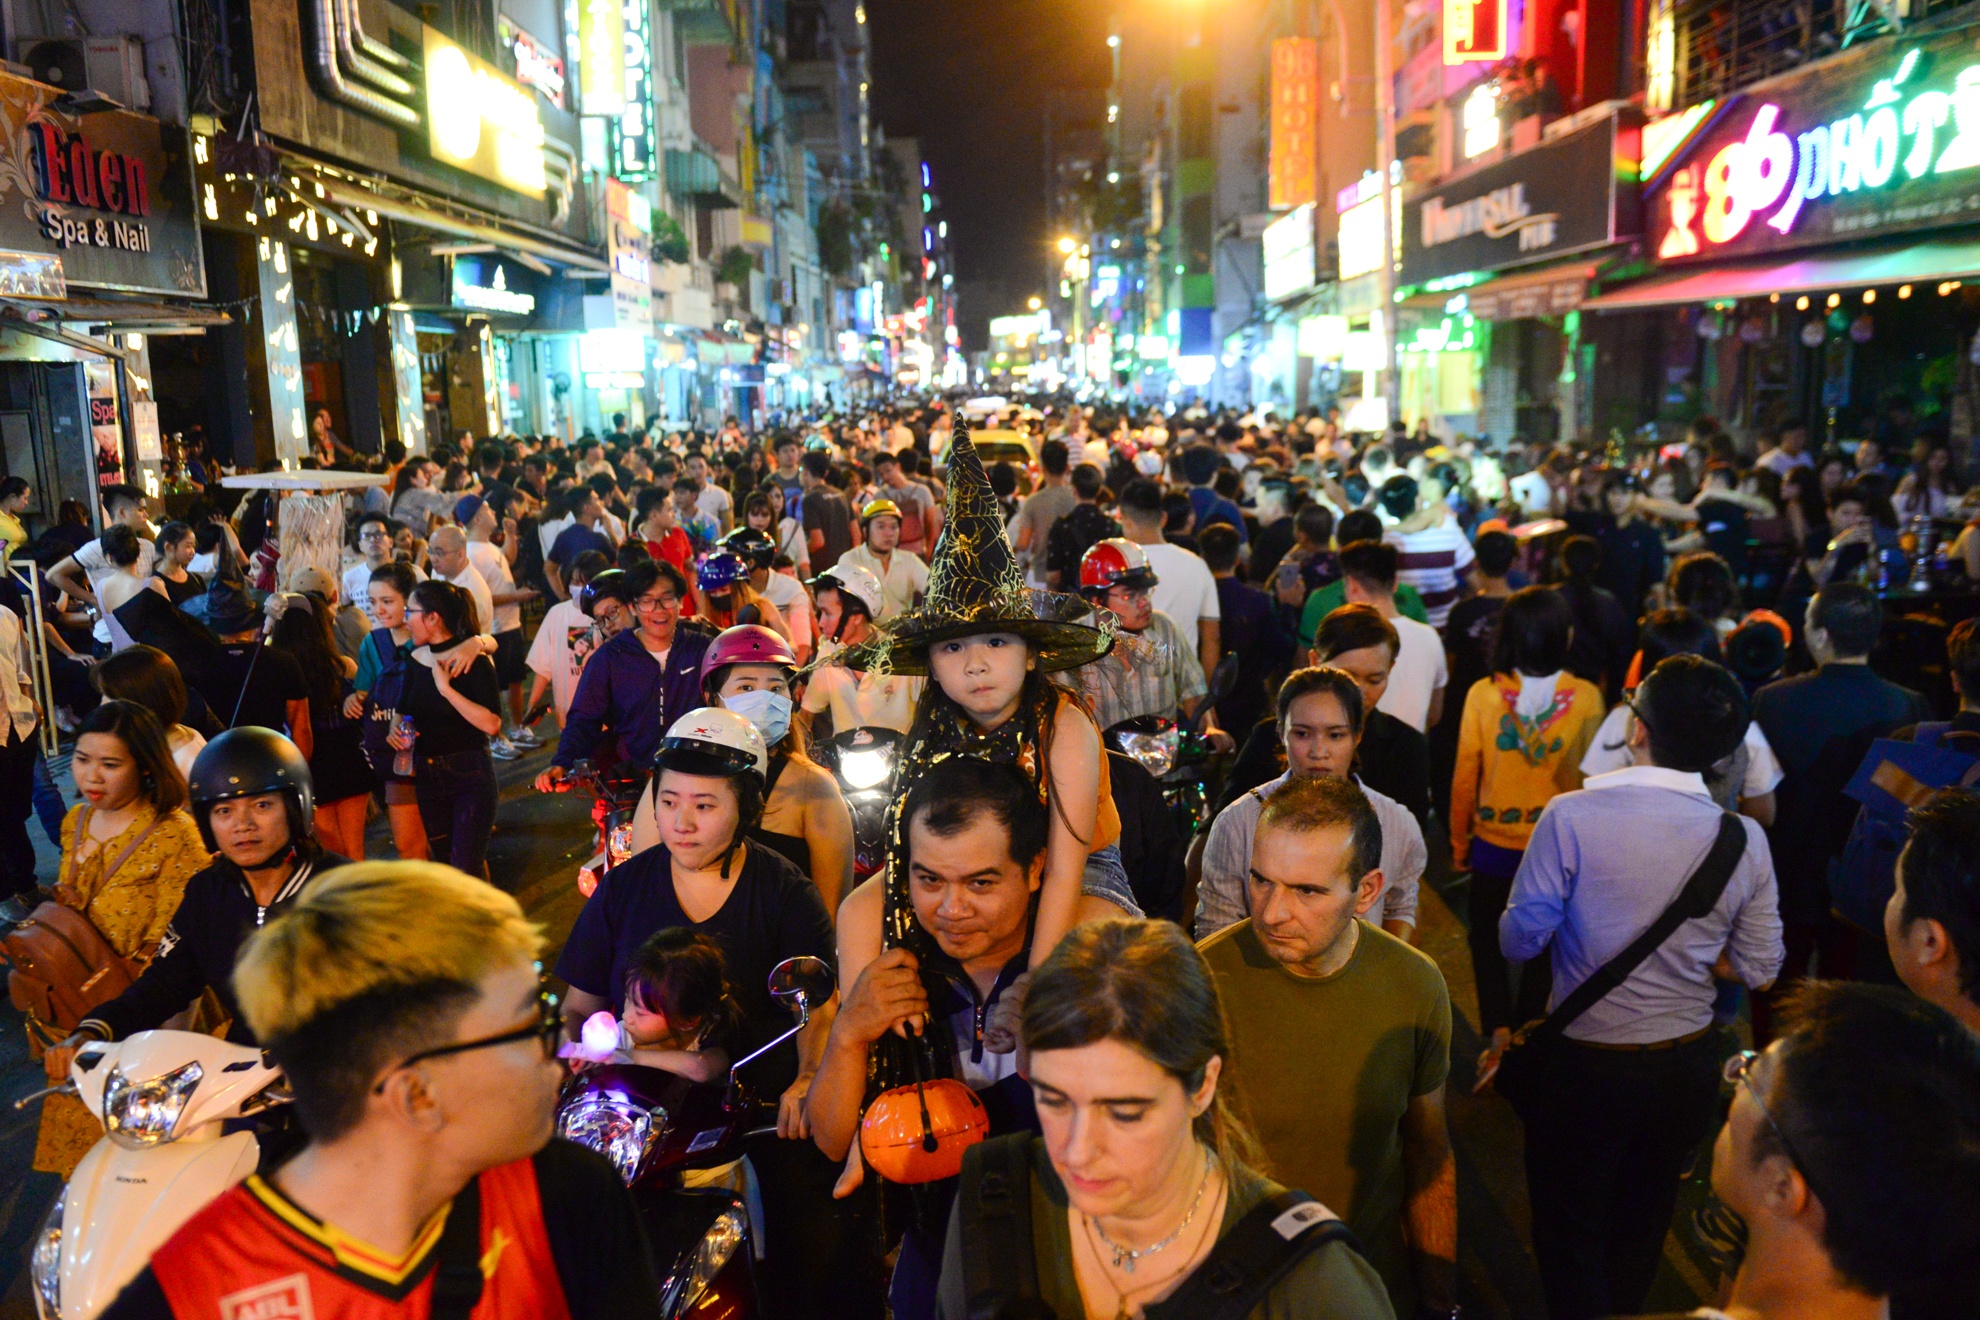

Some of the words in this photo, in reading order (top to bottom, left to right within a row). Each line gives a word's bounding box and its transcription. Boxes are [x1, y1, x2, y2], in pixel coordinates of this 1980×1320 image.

[42, 122, 151, 217] Eden
[1279, 82, 1310, 206] HOTEL
[1703, 102, 1795, 244] 86
[46, 209, 90, 249] Spa
[94, 217, 110, 248] &
[113, 219, 151, 254] Nail
[92, 400, 117, 425] Spa
[370, 702, 396, 722] Smil
